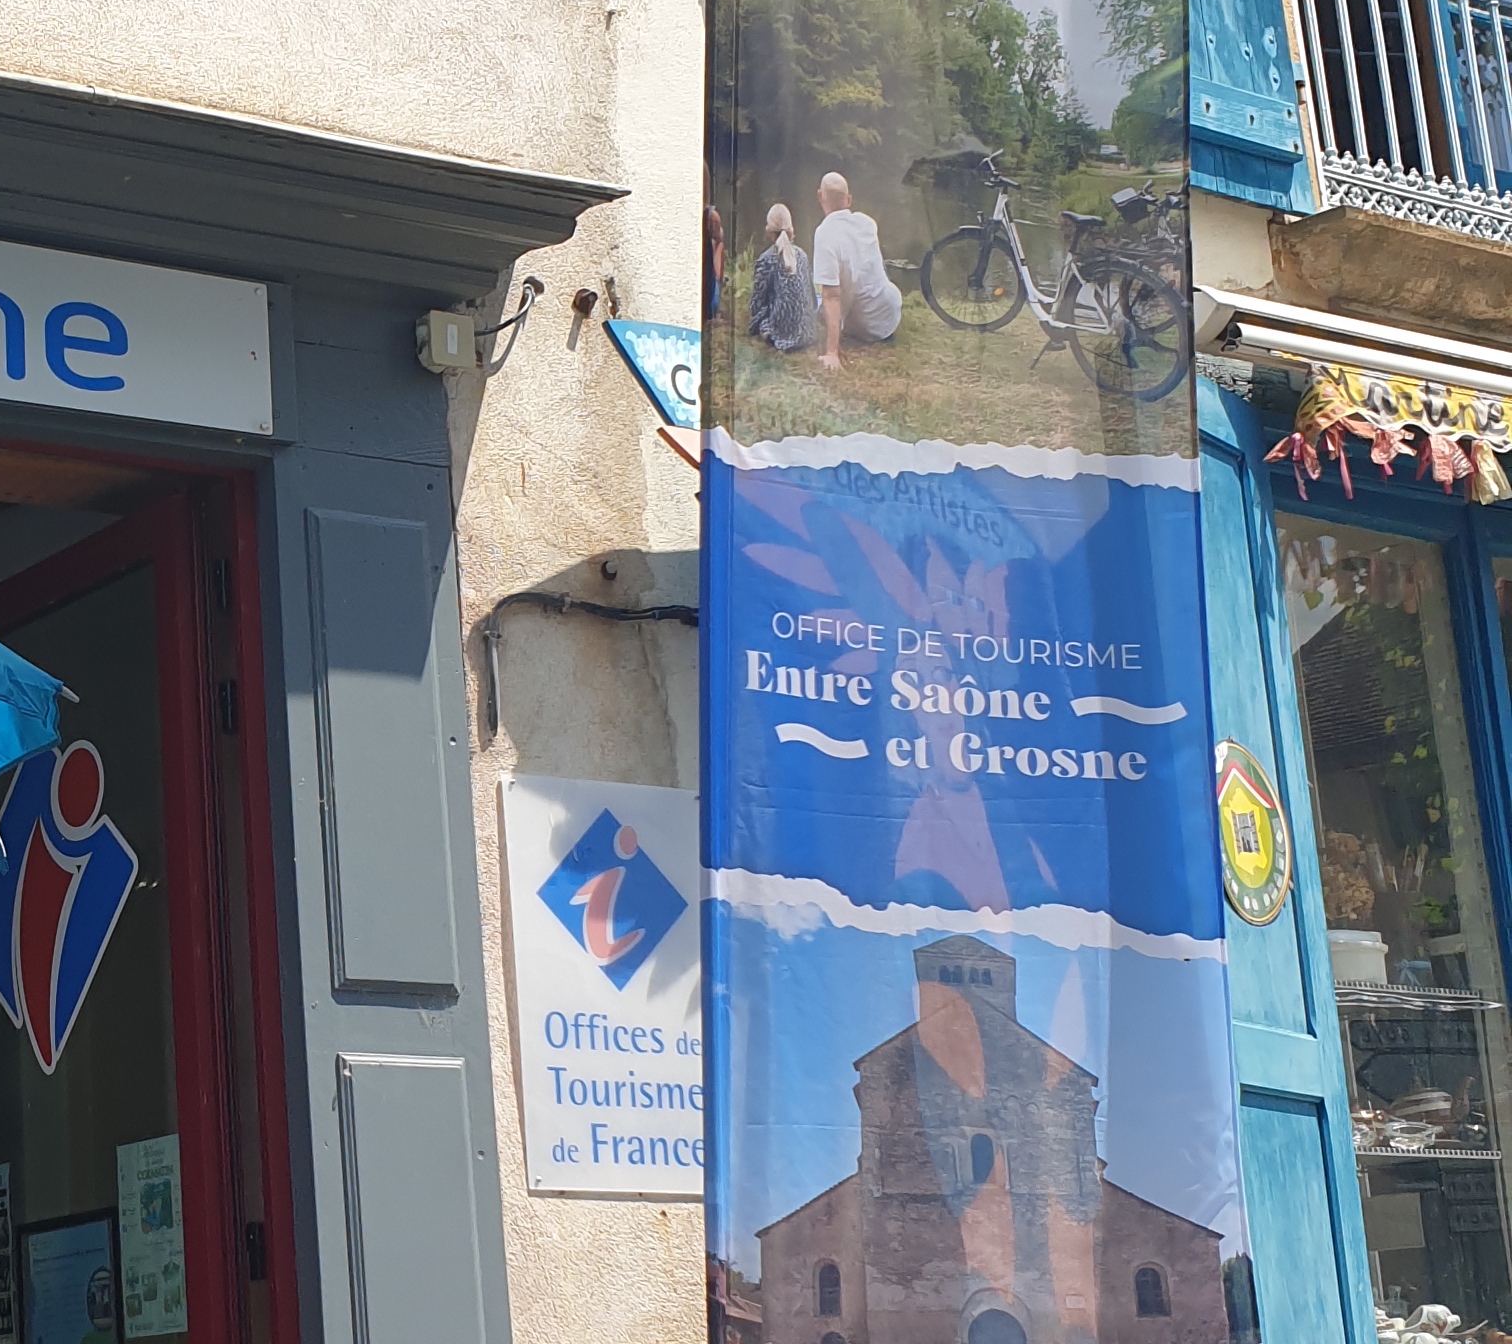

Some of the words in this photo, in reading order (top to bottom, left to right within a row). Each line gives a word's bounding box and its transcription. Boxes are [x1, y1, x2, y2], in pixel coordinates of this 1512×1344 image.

[1319, 364, 1510, 439] Martine
[771, 611, 886, 652] OFFICE
[897, 627, 943, 658] DE
[952, 632, 1143, 670] TOURISME
[744, 649, 873, 706] Entre
[890, 668, 1051, 722] Saône
[886, 735, 932, 769] et
[949, 731, 1148, 781] Grosne
[544, 1010, 665, 1055] Offices
[548, 1066, 705, 1111] Tourisme
[551, 1137, 580, 1163] de
[591, 1123, 705, 1168] France
